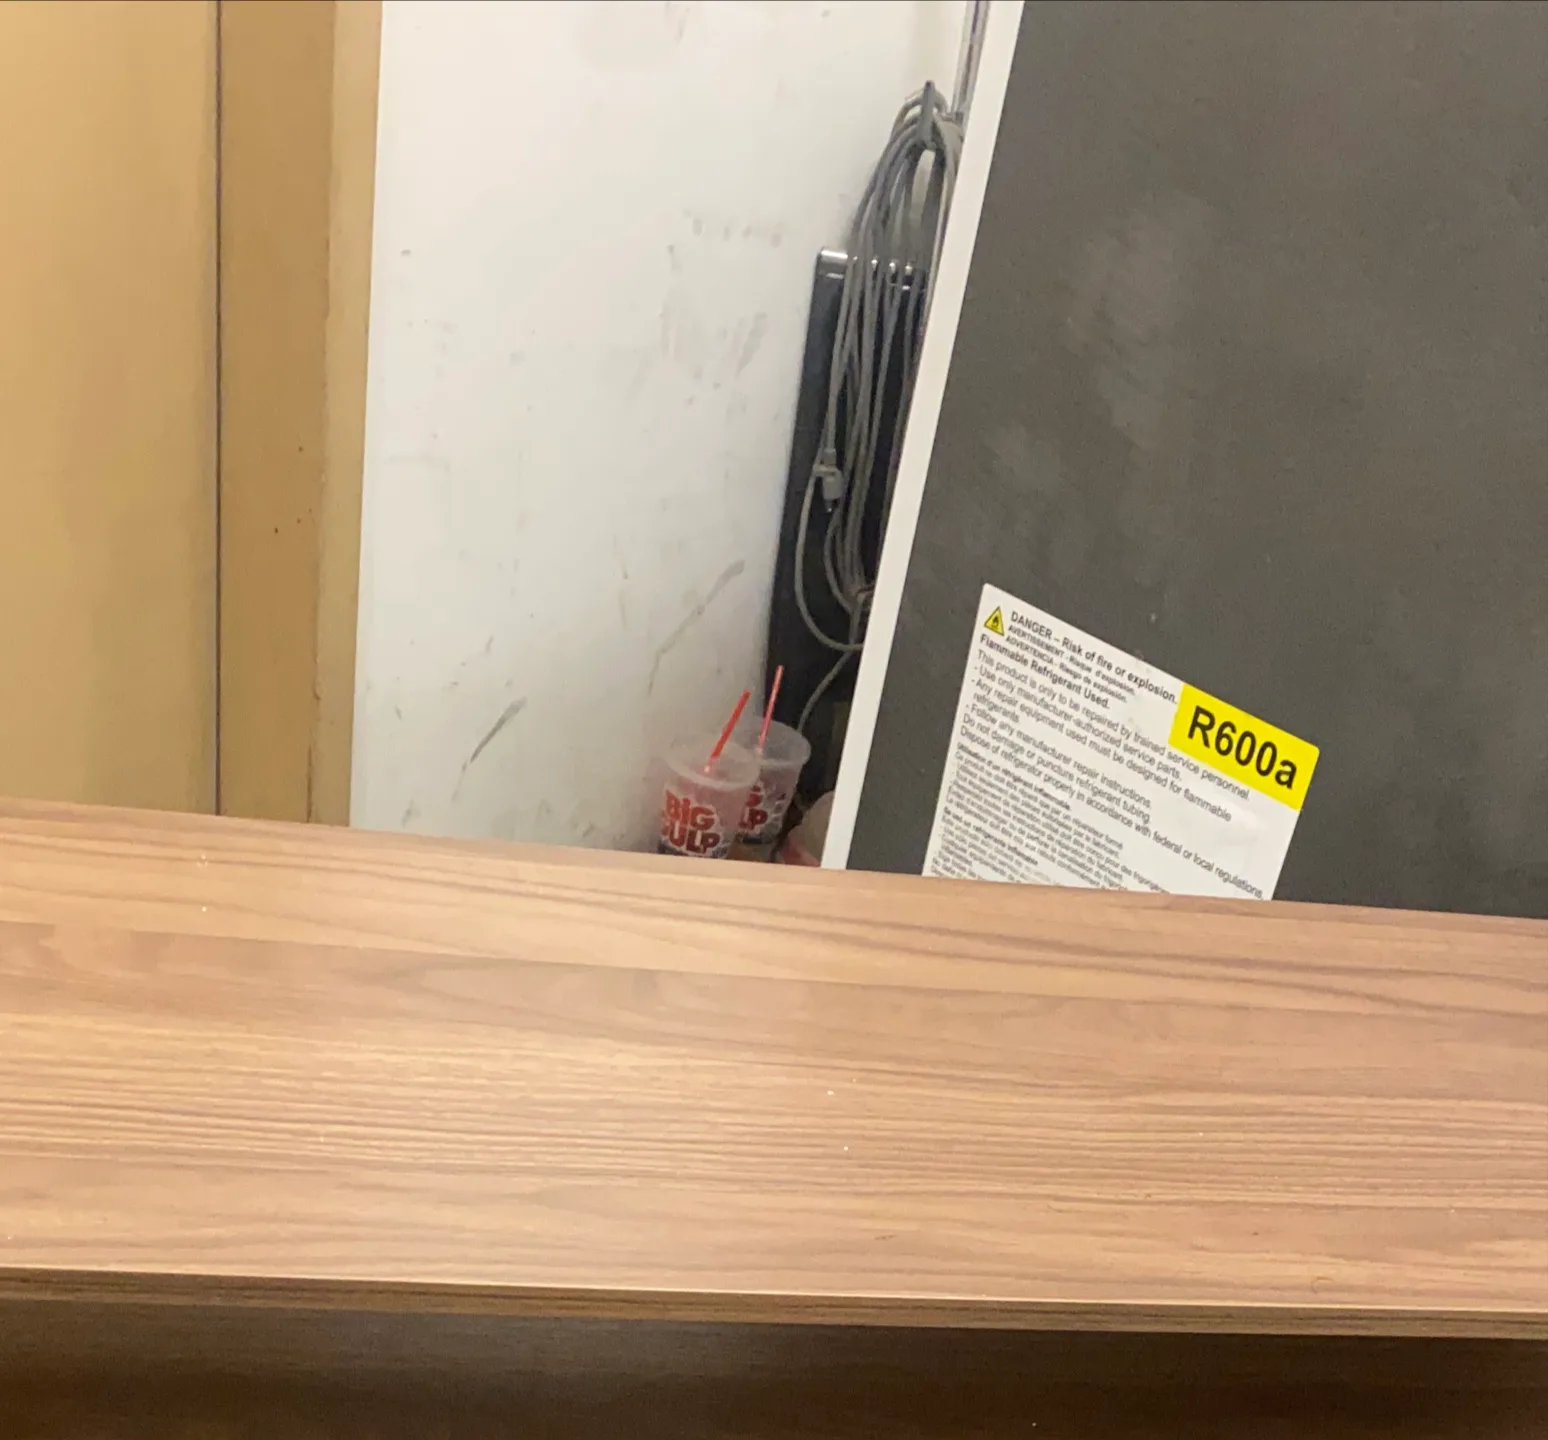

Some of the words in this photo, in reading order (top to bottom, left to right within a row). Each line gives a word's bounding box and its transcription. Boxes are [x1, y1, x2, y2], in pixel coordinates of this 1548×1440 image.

[980, 633, 1028, 666] Flammable
[1030, 659, 1081, 694] Refrigerant
[1083, 687, 1109, 708] Used.
[1010, 610, 1052, 639] DANGER
[1061, 636, 1082, 655] Risk
[1084, 650, 1096, 662] of
[1096, 654, 1112, 671] fire
[1114, 665, 1126, 677] or
[1127, 672, 1176, 704] explosion.
[970, 703, 997, 724] Follow
[998, 721, 1014, 736] any
[1016, 730, 1071, 764] manufacturer
[1072, 760, 1099, 778] repair
[975, 678, 992, 695] Any
[994, 689, 1018, 706] repair
[1019, 703, 1064, 733] equipment
[1065, 728, 1087, 745] used
[1088, 739, 1111, 757] must
[1112, 750, 1124, 764] be
[1125, 759, 1168, 787] designed
[1169, 781, 1181, 793] for
[1183, 788, 1231, 821] flammable
[978, 648, 994, 666] This
[995, 661, 1028, 684] product
[1028, 676, 1037, 689] is
[1037, 684, 1057, 700] only
[1058, 692, 1067, 704] to
[1069, 698, 1080, 711] be
[1081, 706, 1119, 732] repaired
[1119, 724, 1132, 740] by
[1133, 731, 1166, 756] trained
[1166, 751, 1199, 774] service
[979, 665, 996, 681] Use
[997, 676, 1015, 693] only
[1122, 743, 1155, 765] service
[1156, 761, 1181, 780] parts.
[1187, 705, 1296, 789] R600a
[960, 725, 990, 749] Dispose
[991, 744, 1001, 754] of
[1000, 749, 1042, 777] refrigerator
[1043, 773, 1075, 798] properly
[1076, 790, 1085, 802] in
[1085, 796, 1133, 827] accordance
[1134, 823, 1151, 837] with
[1152, 832, 1182, 854] federal
[1182, 850, 1192, 860] or
[1192, 854, 1213, 871] local
[962, 712, 975, 726] Do
[975, 722, 990, 735] not
[990, 730, 1025, 754] damage
[1026, 749, 1036, 759] or
[1036, 755, 1074, 781] puncture
[1075, 776, 1121, 806] refrigerant
[665, 789, 716, 831] BIG
